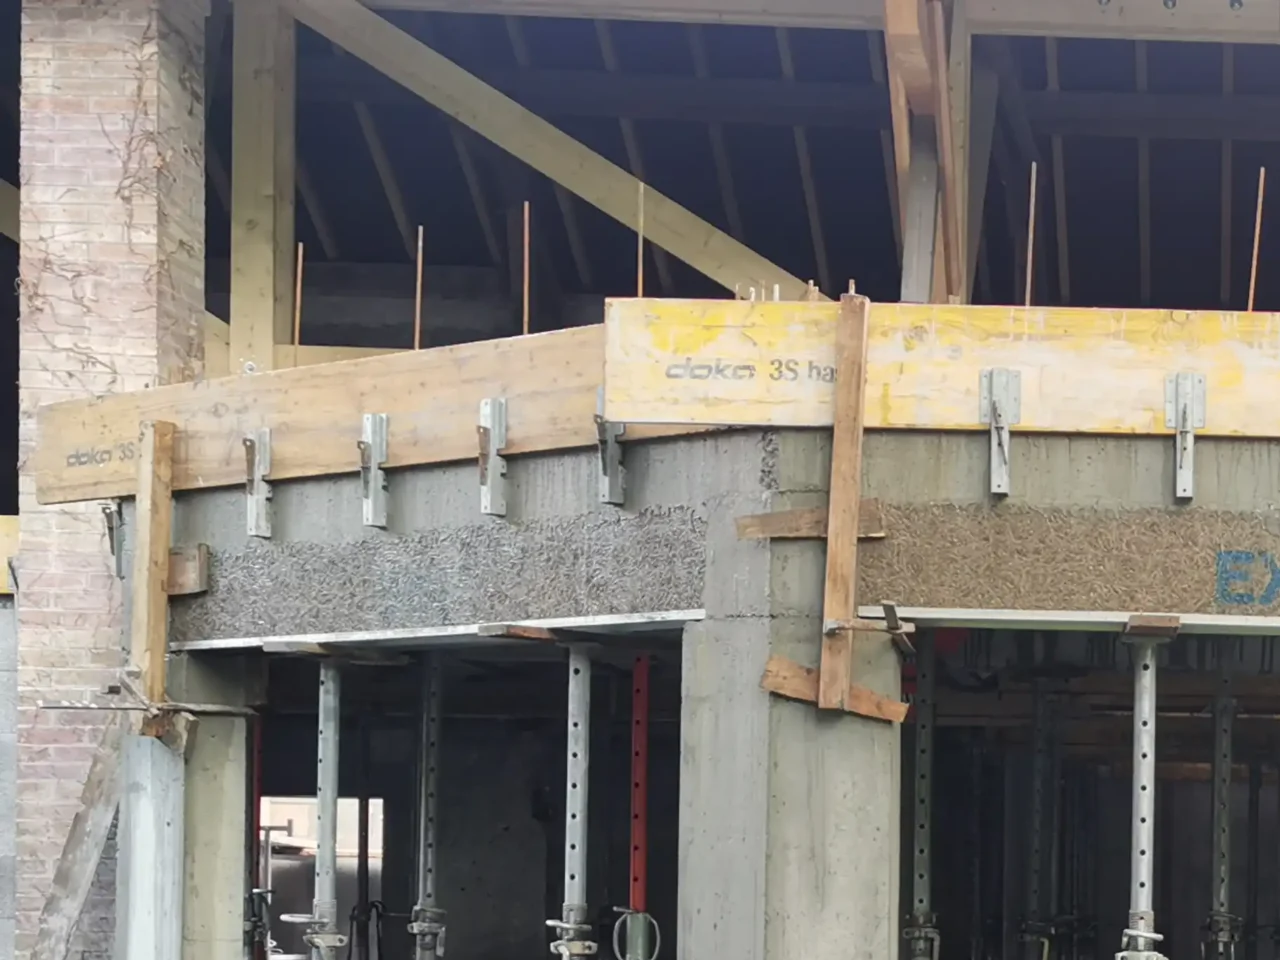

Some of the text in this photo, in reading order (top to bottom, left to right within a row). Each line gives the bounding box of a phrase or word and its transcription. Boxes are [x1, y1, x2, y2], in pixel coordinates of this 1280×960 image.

[664, 357, 757, 380] doka
[769, 359, 799, 381] 3S
[66, 447, 112, 467] doka
